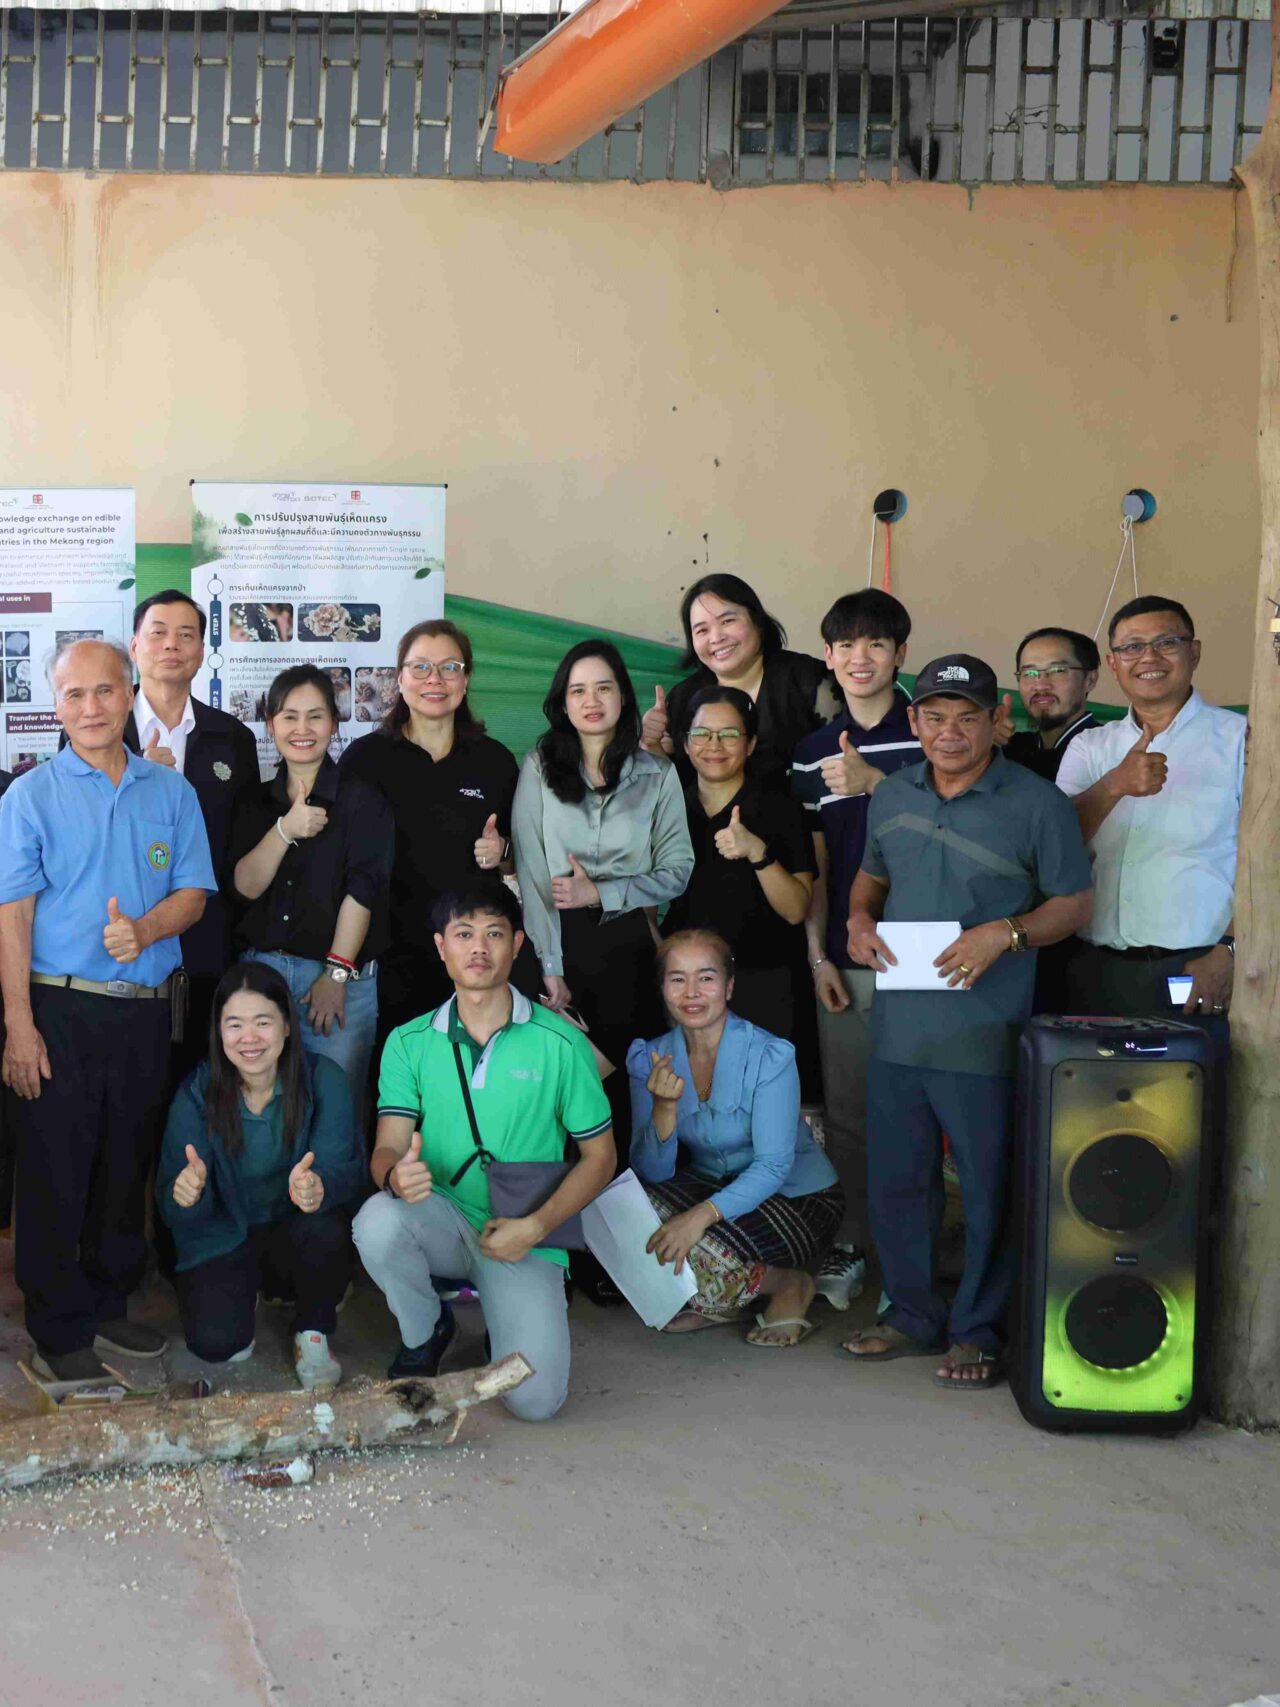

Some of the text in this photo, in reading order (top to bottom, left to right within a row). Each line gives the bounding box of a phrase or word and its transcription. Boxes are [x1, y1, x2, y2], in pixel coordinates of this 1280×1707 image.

[38, 514, 79, 523] exchange
[254, 511, 388, 525] การปรับปรุงสายพันธุ์เห็ดแครง
[0, 526, 15, 534] and
[17, 526, 65, 535] agriculture
[67, 525, 116, 533] sustainable
[33, 537, 48, 545] the
[49, 537, 85, 546] Mekong
[86, 537, 114, 546] region
[8, 714, 38, 722] Transfer
[8, 722, 64, 731] and knowledge
